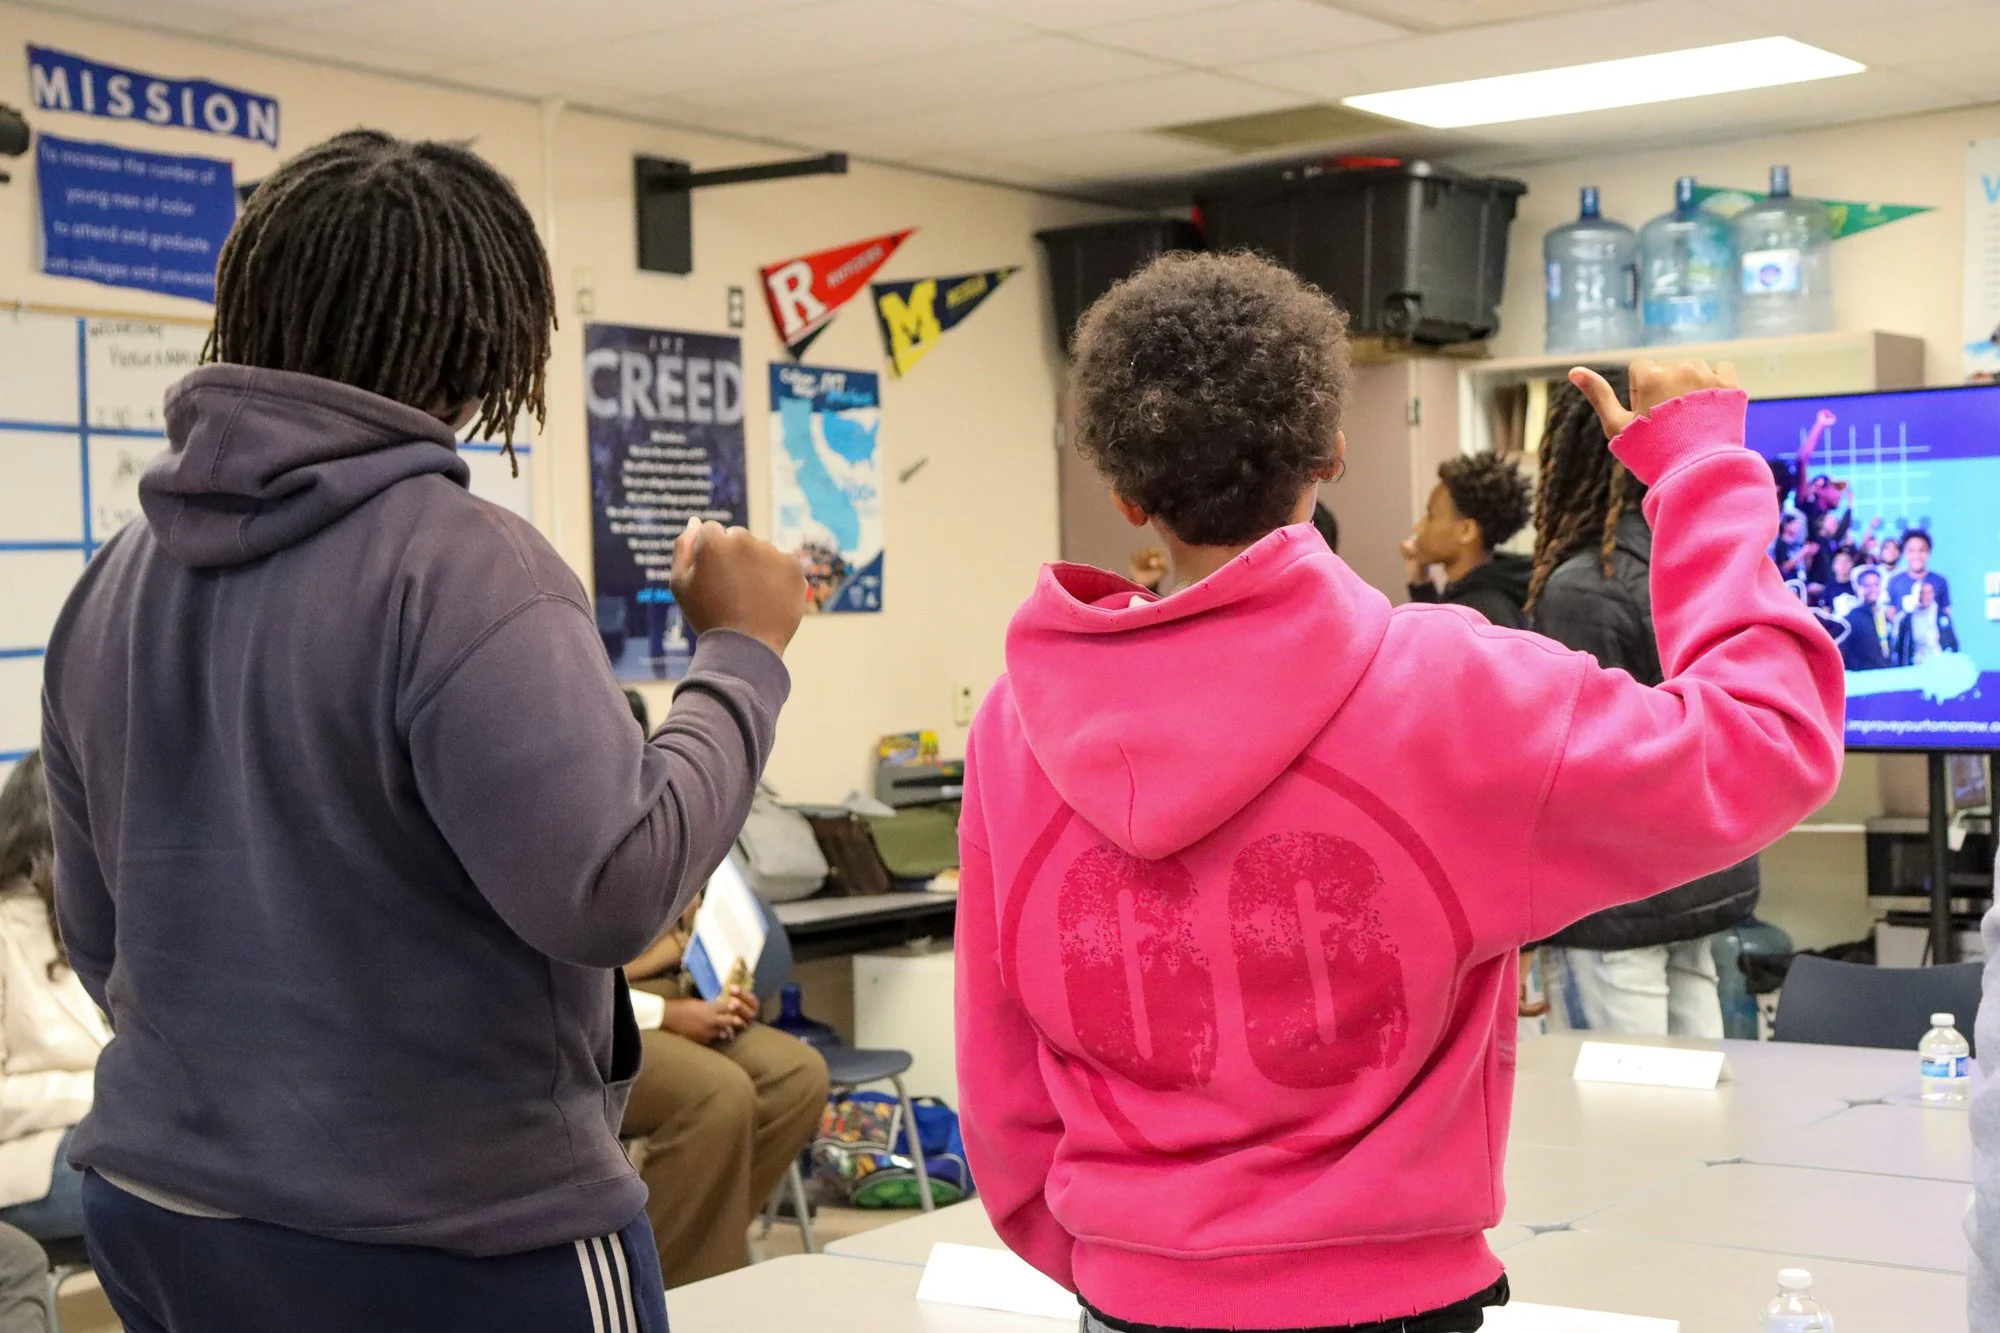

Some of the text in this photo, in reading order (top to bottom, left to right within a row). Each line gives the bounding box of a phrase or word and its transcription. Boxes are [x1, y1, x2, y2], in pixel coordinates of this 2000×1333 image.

[31, 63, 278, 143] MISSION
[123, 157, 147, 175] the
[148, 163, 198, 183] number
[199, 167, 216, 185] of
[66, 188, 195, 217] young men of color
[54, 220, 211, 254] to attend and graduate
[130, 263, 159, 282] and
[767, 260, 829, 341] R
[879, 278, 943, 374] M
[585, 347, 744, 425] CREED
